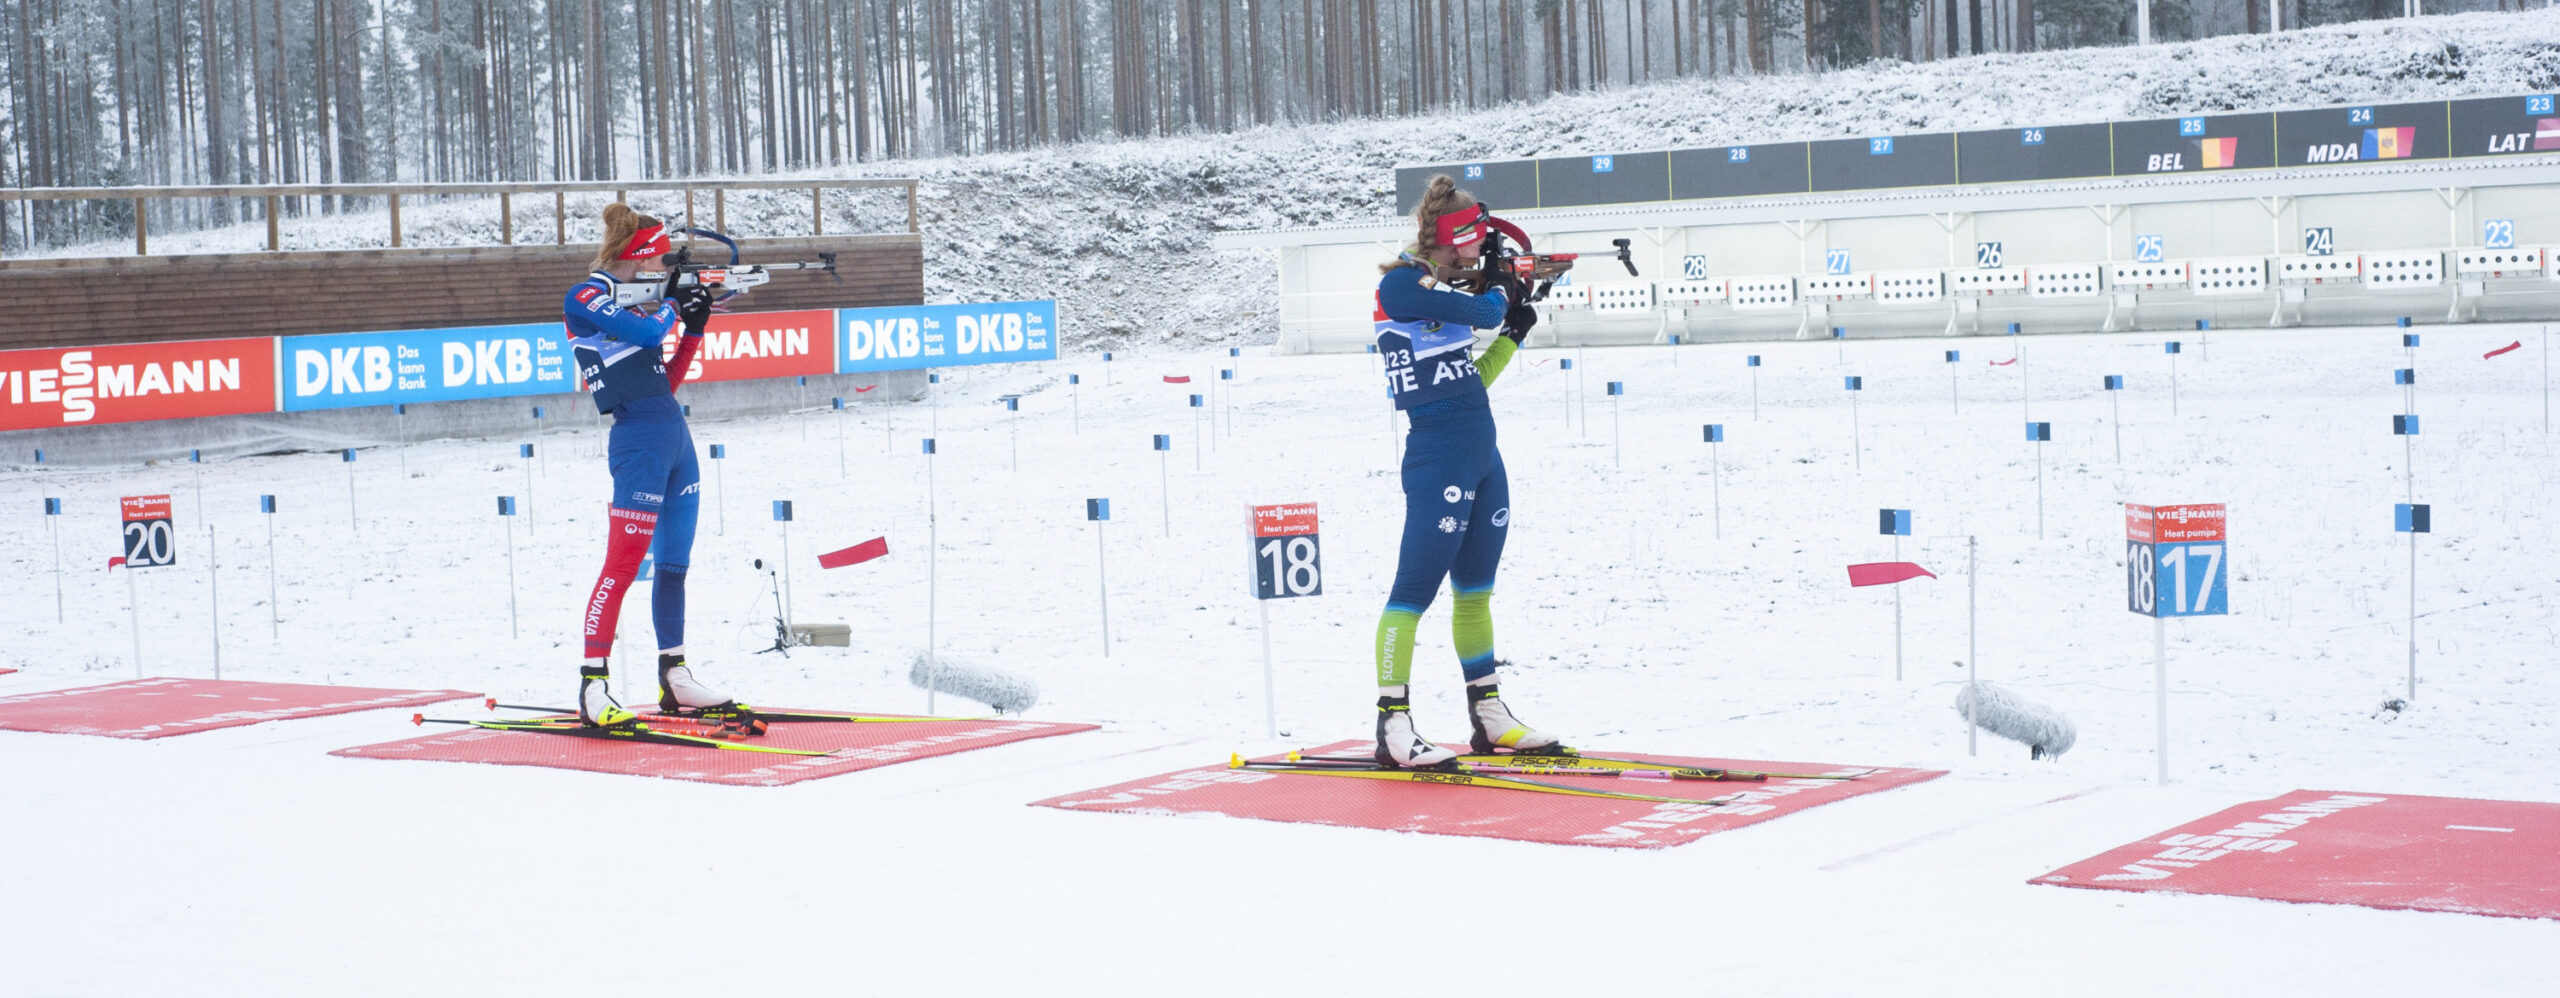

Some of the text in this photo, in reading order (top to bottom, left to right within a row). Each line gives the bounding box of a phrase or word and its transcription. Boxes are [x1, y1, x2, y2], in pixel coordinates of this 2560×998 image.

[2530, 98, 2551, 111] 23
[2352, 109, 2371, 122] 24
[2184, 120, 2202, 133] 25
[2024, 130, 2043, 142] 26
[2488, 133, 2531, 153] LAT
[1874, 139, 1890, 152] 27
[2307, 143, 2359, 163] MDA
[1731, 148, 1747, 160] 28
[2147, 153, 2184, 171] BEL
[1595, 157, 1611, 170] 29
[1467, 166, 1482, 178] 30
[2306, 228, 2332, 255] 24
[2486, 221, 2512, 248] 23
[1978, 243, 2002, 268] 26
[2138, 236, 2162, 261] 25
[1684, 256, 1706, 280] 28
[1827, 250, 1850, 274] 27
[923, 316, 940, 329] Das
[849, 317, 920, 361] DKB
[956, 312, 1024, 355] DKB
[397, 344, 419, 359] Das
[537, 337, 557, 351] Das
[398, 359, 425, 375] kann
[442, 338, 532, 388] DKB
[537, 352, 562, 366] kann
[296, 346, 393, 397] DKB
[537, 366, 563, 381] Bank
[0, 351, 240, 423] IESSMANN
[398, 375, 427, 391] Bank
[123, 497, 170, 508] VIESSMANN
[145, 511, 165, 519] pumps
[1256, 506, 1316, 521] VIESSMANN
[2156, 507, 2225, 524] VIESSMANN
[1264, 525, 1282, 533] Heat
[1284, 524, 1310, 534] pumps
[2164, 529, 2185, 538] Heat
[2187, 529, 2218, 539] pumps
[124, 520, 174, 566] 20
[1260, 537, 1319, 596] 18
[2128, 544, 2154, 613] 18
[2161, 544, 2223, 613] 17
[585, 577, 615, 635] SLOVAKIA
[1382, 626, 1398, 681] SLOVENIA
[1511, 757, 1580, 767] FISCHER
[1411, 772, 1473, 785] FISCHER
[2092, 794, 2389, 881] VIESSMANN
